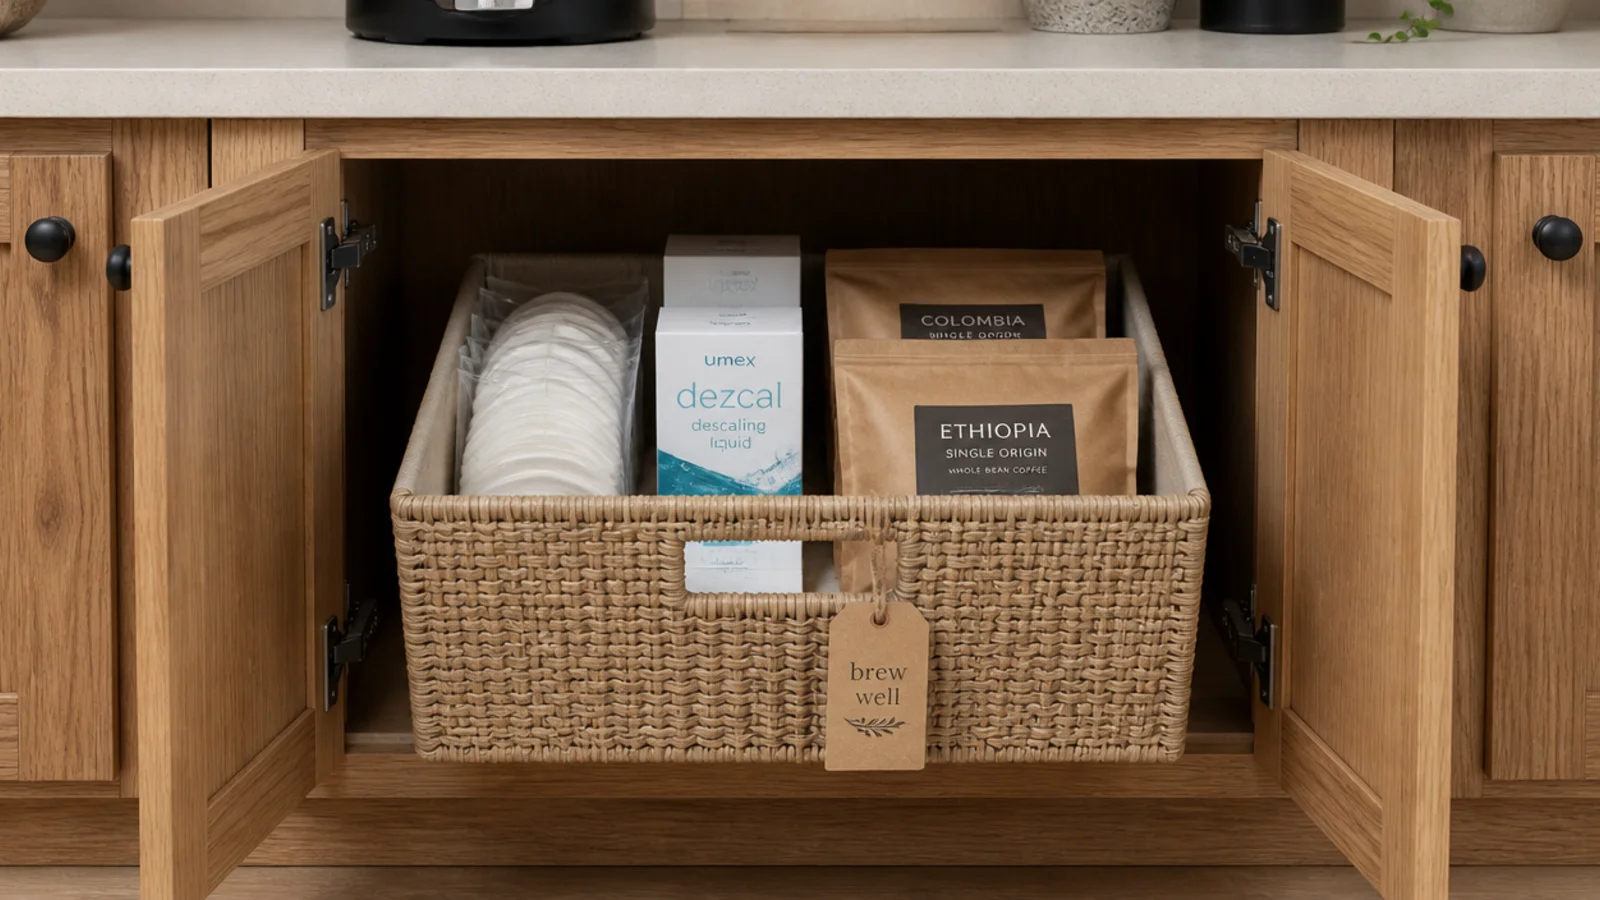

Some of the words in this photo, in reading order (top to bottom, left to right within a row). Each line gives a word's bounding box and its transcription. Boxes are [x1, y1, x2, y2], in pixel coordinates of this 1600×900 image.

[921, 315, 1026, 327] COLOMBIA
[704, 355, 756, 367] umex
[676, 381, 782, 409] dezcal
[691, 418, 766, 434] descaling
[940, 422, 1052, 440] ETHIOPIA
[710, 436, 752, 452] liquid
[946, 448, 994, 459] SINGLE
[999, 447, 1048, 459] ORIGIN
[850, 661, 908, 681] brew
[855, 687, 900, 706] well
